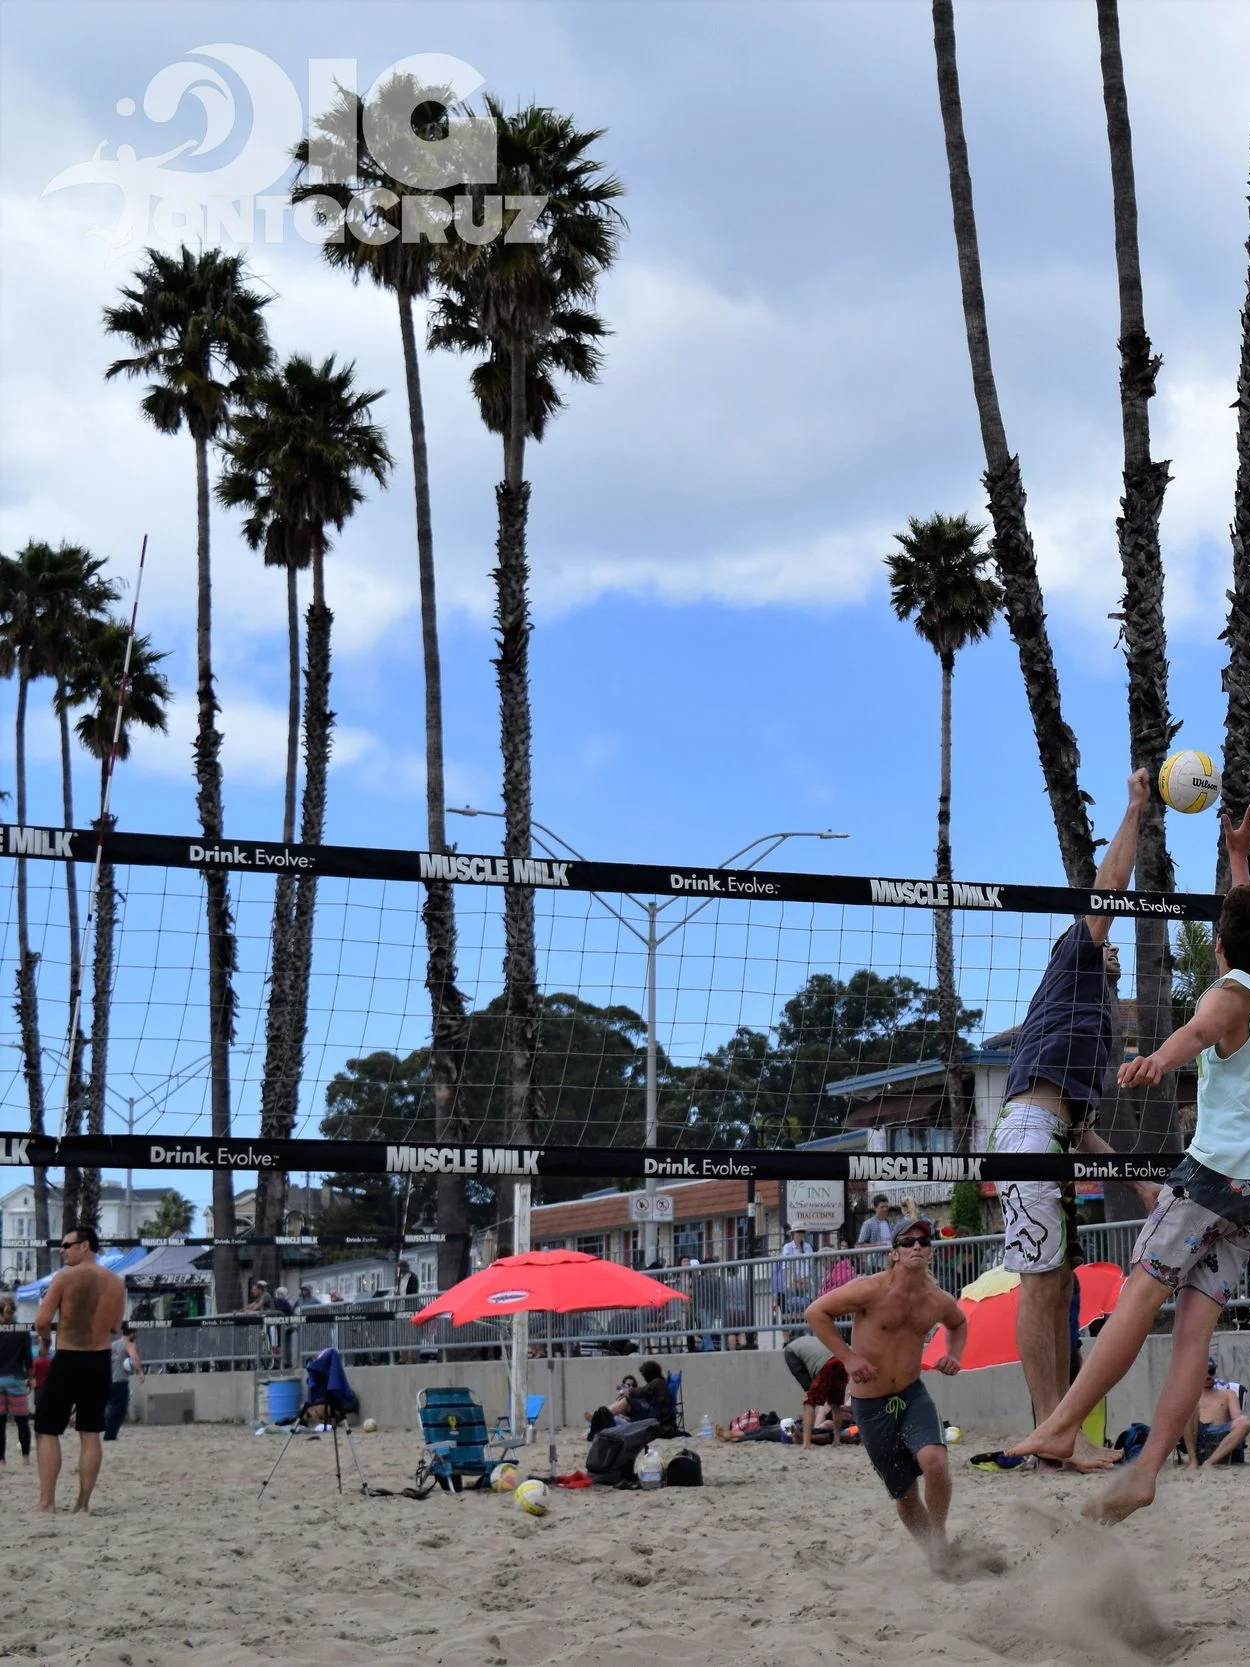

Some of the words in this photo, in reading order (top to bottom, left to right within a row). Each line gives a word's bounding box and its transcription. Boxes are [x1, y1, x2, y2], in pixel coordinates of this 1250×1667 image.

[1192, 777, 1218, 791] Wilson
[9, 826, 73, 857] MILK
[189, 845, 252, 865] Drink.
[419, 853, 510, 883] MUSCLE
[512, 858, 570, 887] MILK
[670, 873, 726, 892] Drink.
[869, 879, 949, 906] MUSCLE
[951, 883, 1003, 909] MILK
[1090, 894, 1140, 911] Drink.
[0, 1137, 30, 1164] LK
[150, 1145, 214, 1164] Drink.
[386, 1145, 478, 1173] MUSCLE
[482, 1148, 540, 1175] MILK
[644, 1157, 700, 1175] Drink.
[848, 1155, 929, 1180] MUSCLE
[932, 1156, 982, 1181] MILK
[1074, 1161, 1122, 1177] Drink.
[807, 1187, 831, 1199] INN
